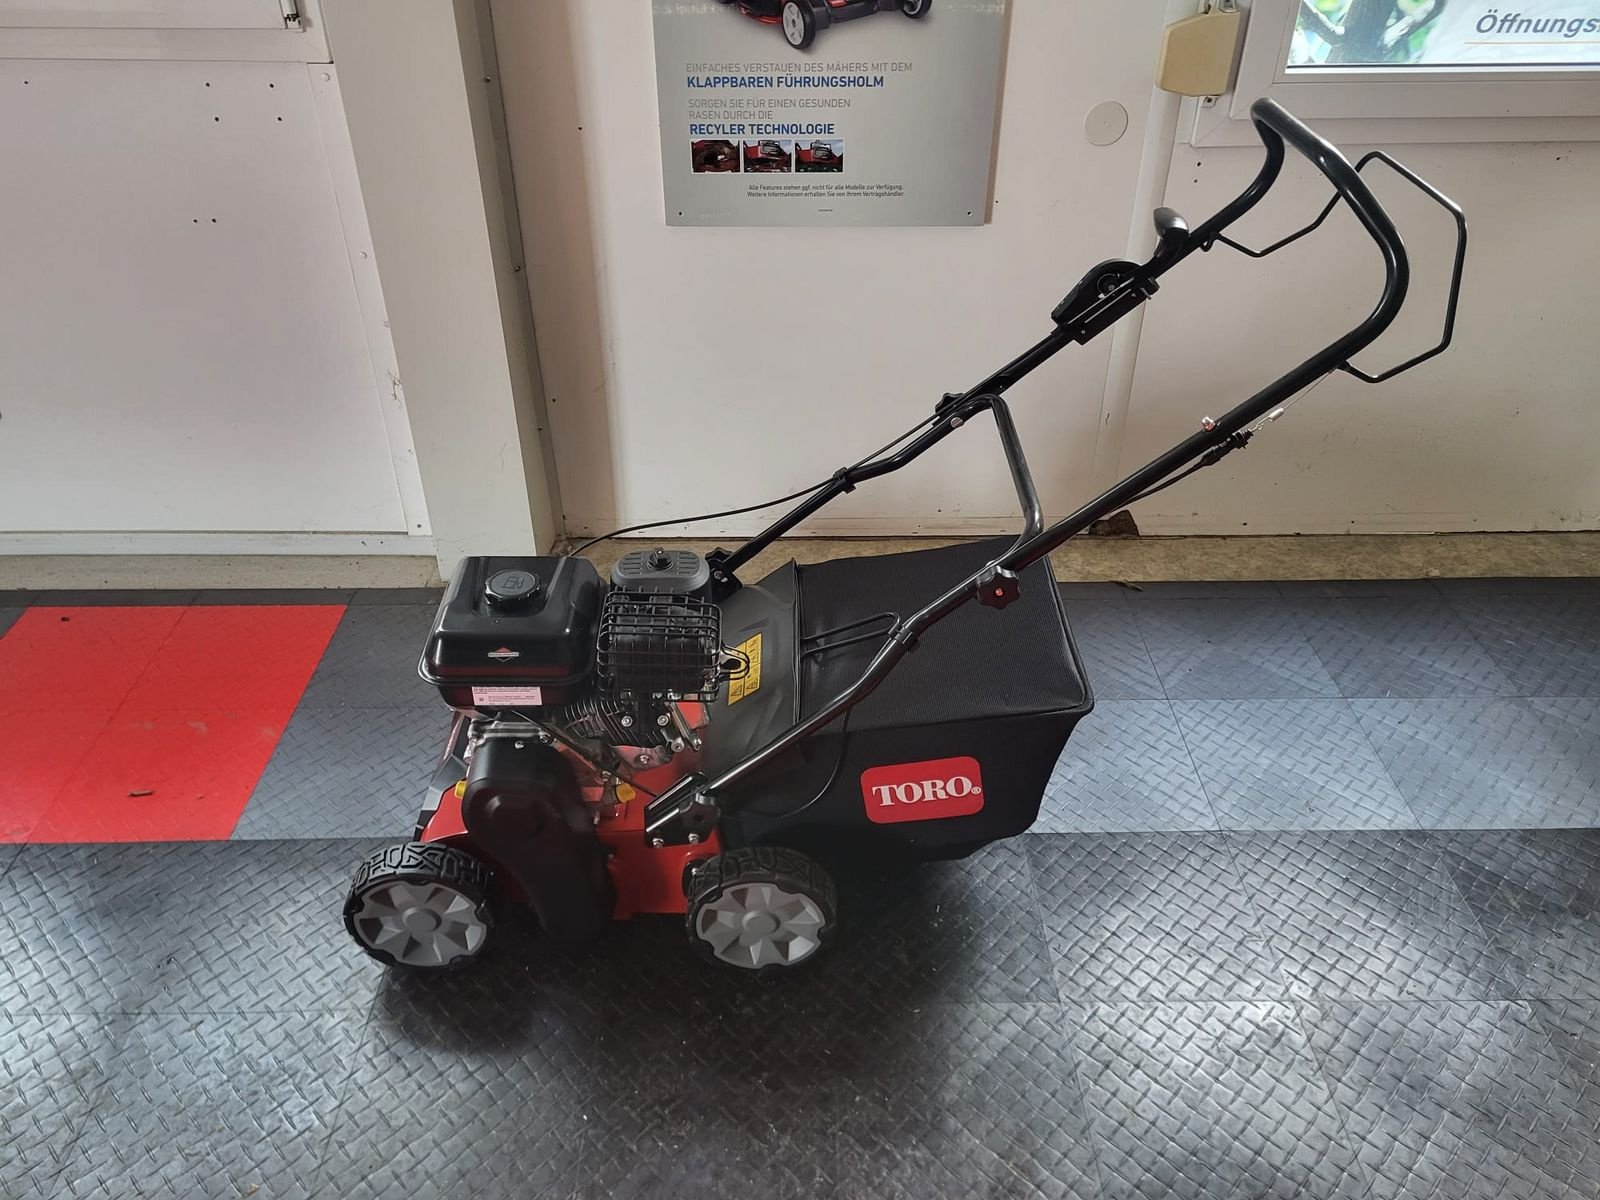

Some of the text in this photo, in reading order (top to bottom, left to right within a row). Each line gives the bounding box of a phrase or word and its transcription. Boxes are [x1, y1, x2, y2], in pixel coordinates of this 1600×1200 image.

[1476, 8, 1600, 38] Öffnungs
[686, 61, 912, 73] EINFACHES VERSTAUEN DES MÄHERS MIT DEM
[687, 73, 884, 88] KLAPPBAREN FÜHRUNGSHOLM
[688, 97, 850, 108] SORGEN SIE FÜR EINEN GESUNDEN
[689, 110, 773, 120] RASEN DURCH DIE
[690, 123, 835, 135] RECYLER TECHNOLOGIE
